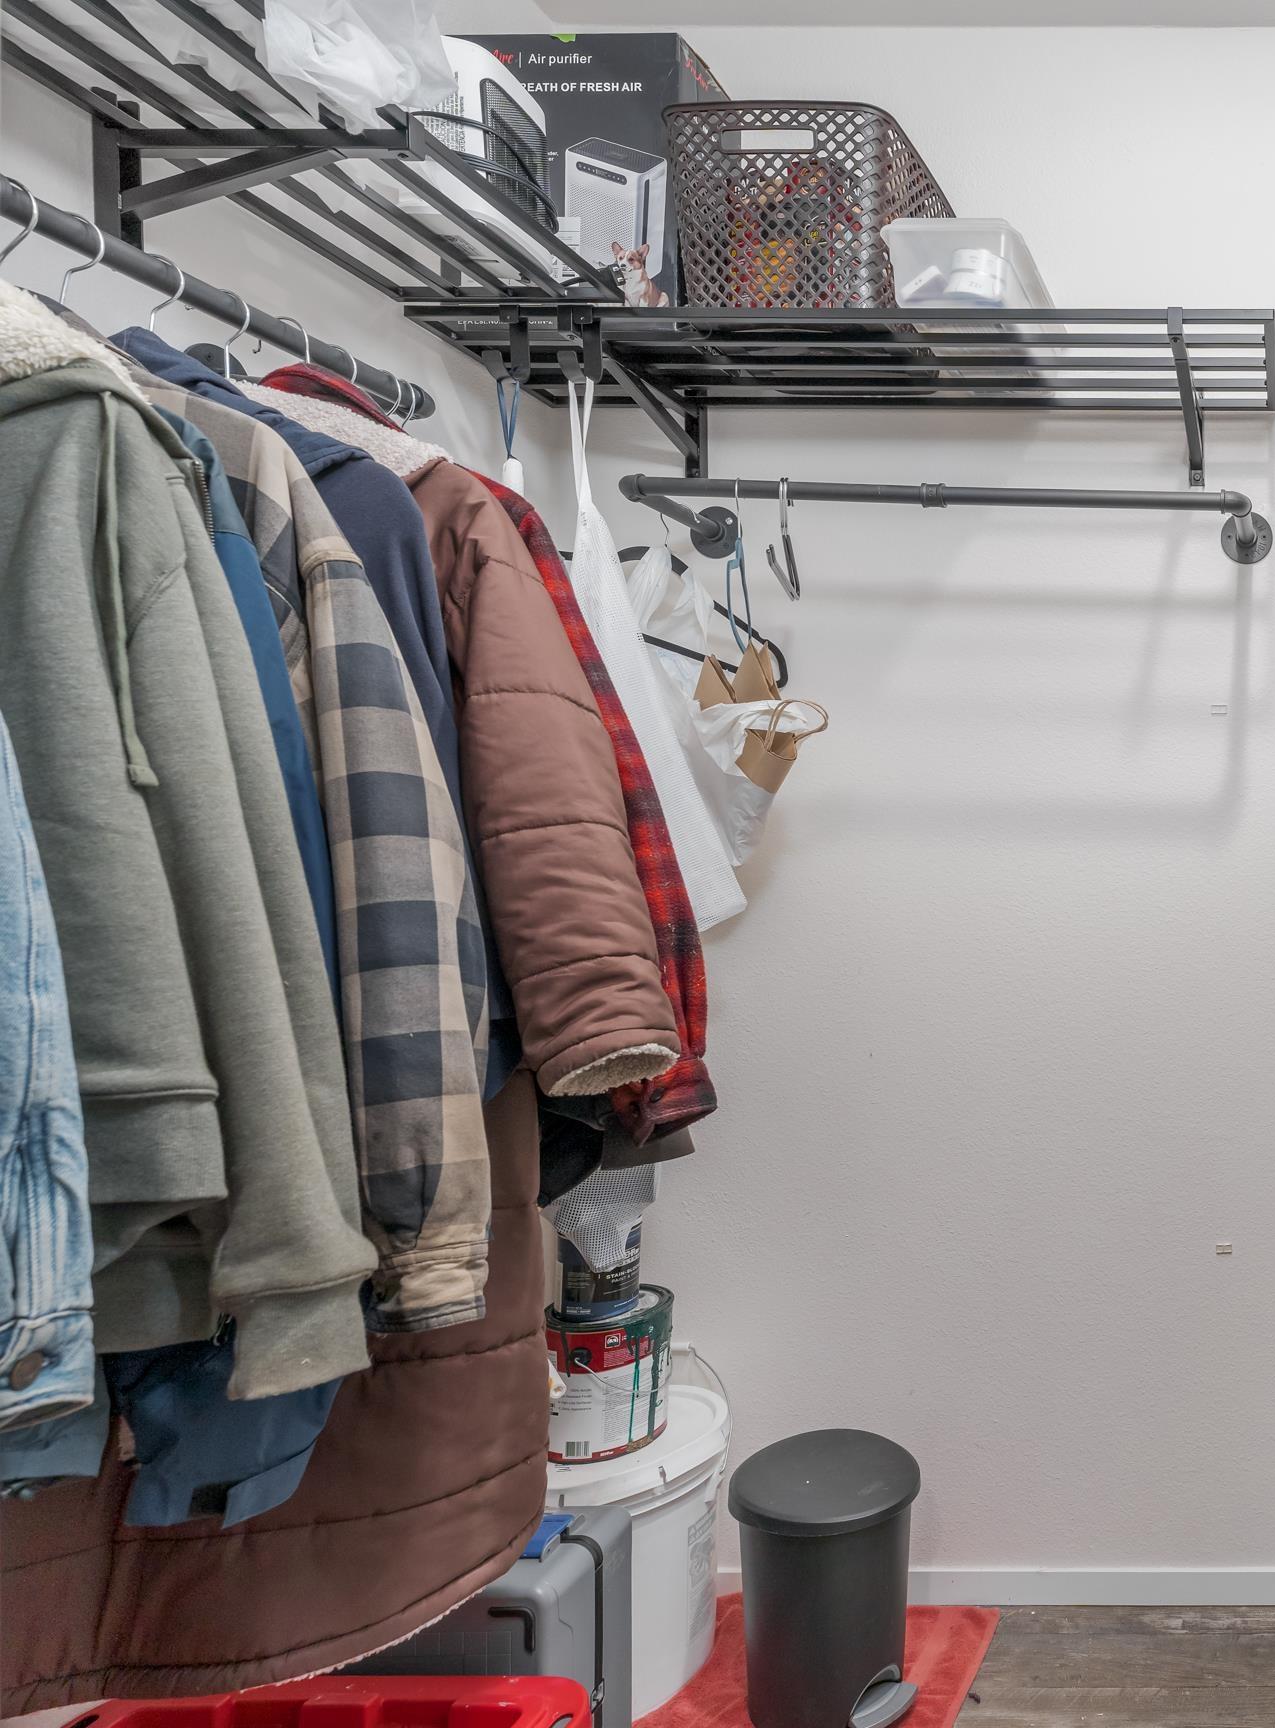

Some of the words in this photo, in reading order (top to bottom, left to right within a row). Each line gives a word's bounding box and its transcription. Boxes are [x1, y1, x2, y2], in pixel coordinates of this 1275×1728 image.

[528, 53, 546, 64] Air
[549, 53, 592, 66] purifier
[560, 82, 577, 92] OF
[579, 82, 619, 92] FRESH
[621, 82, 642, 92] AIR
